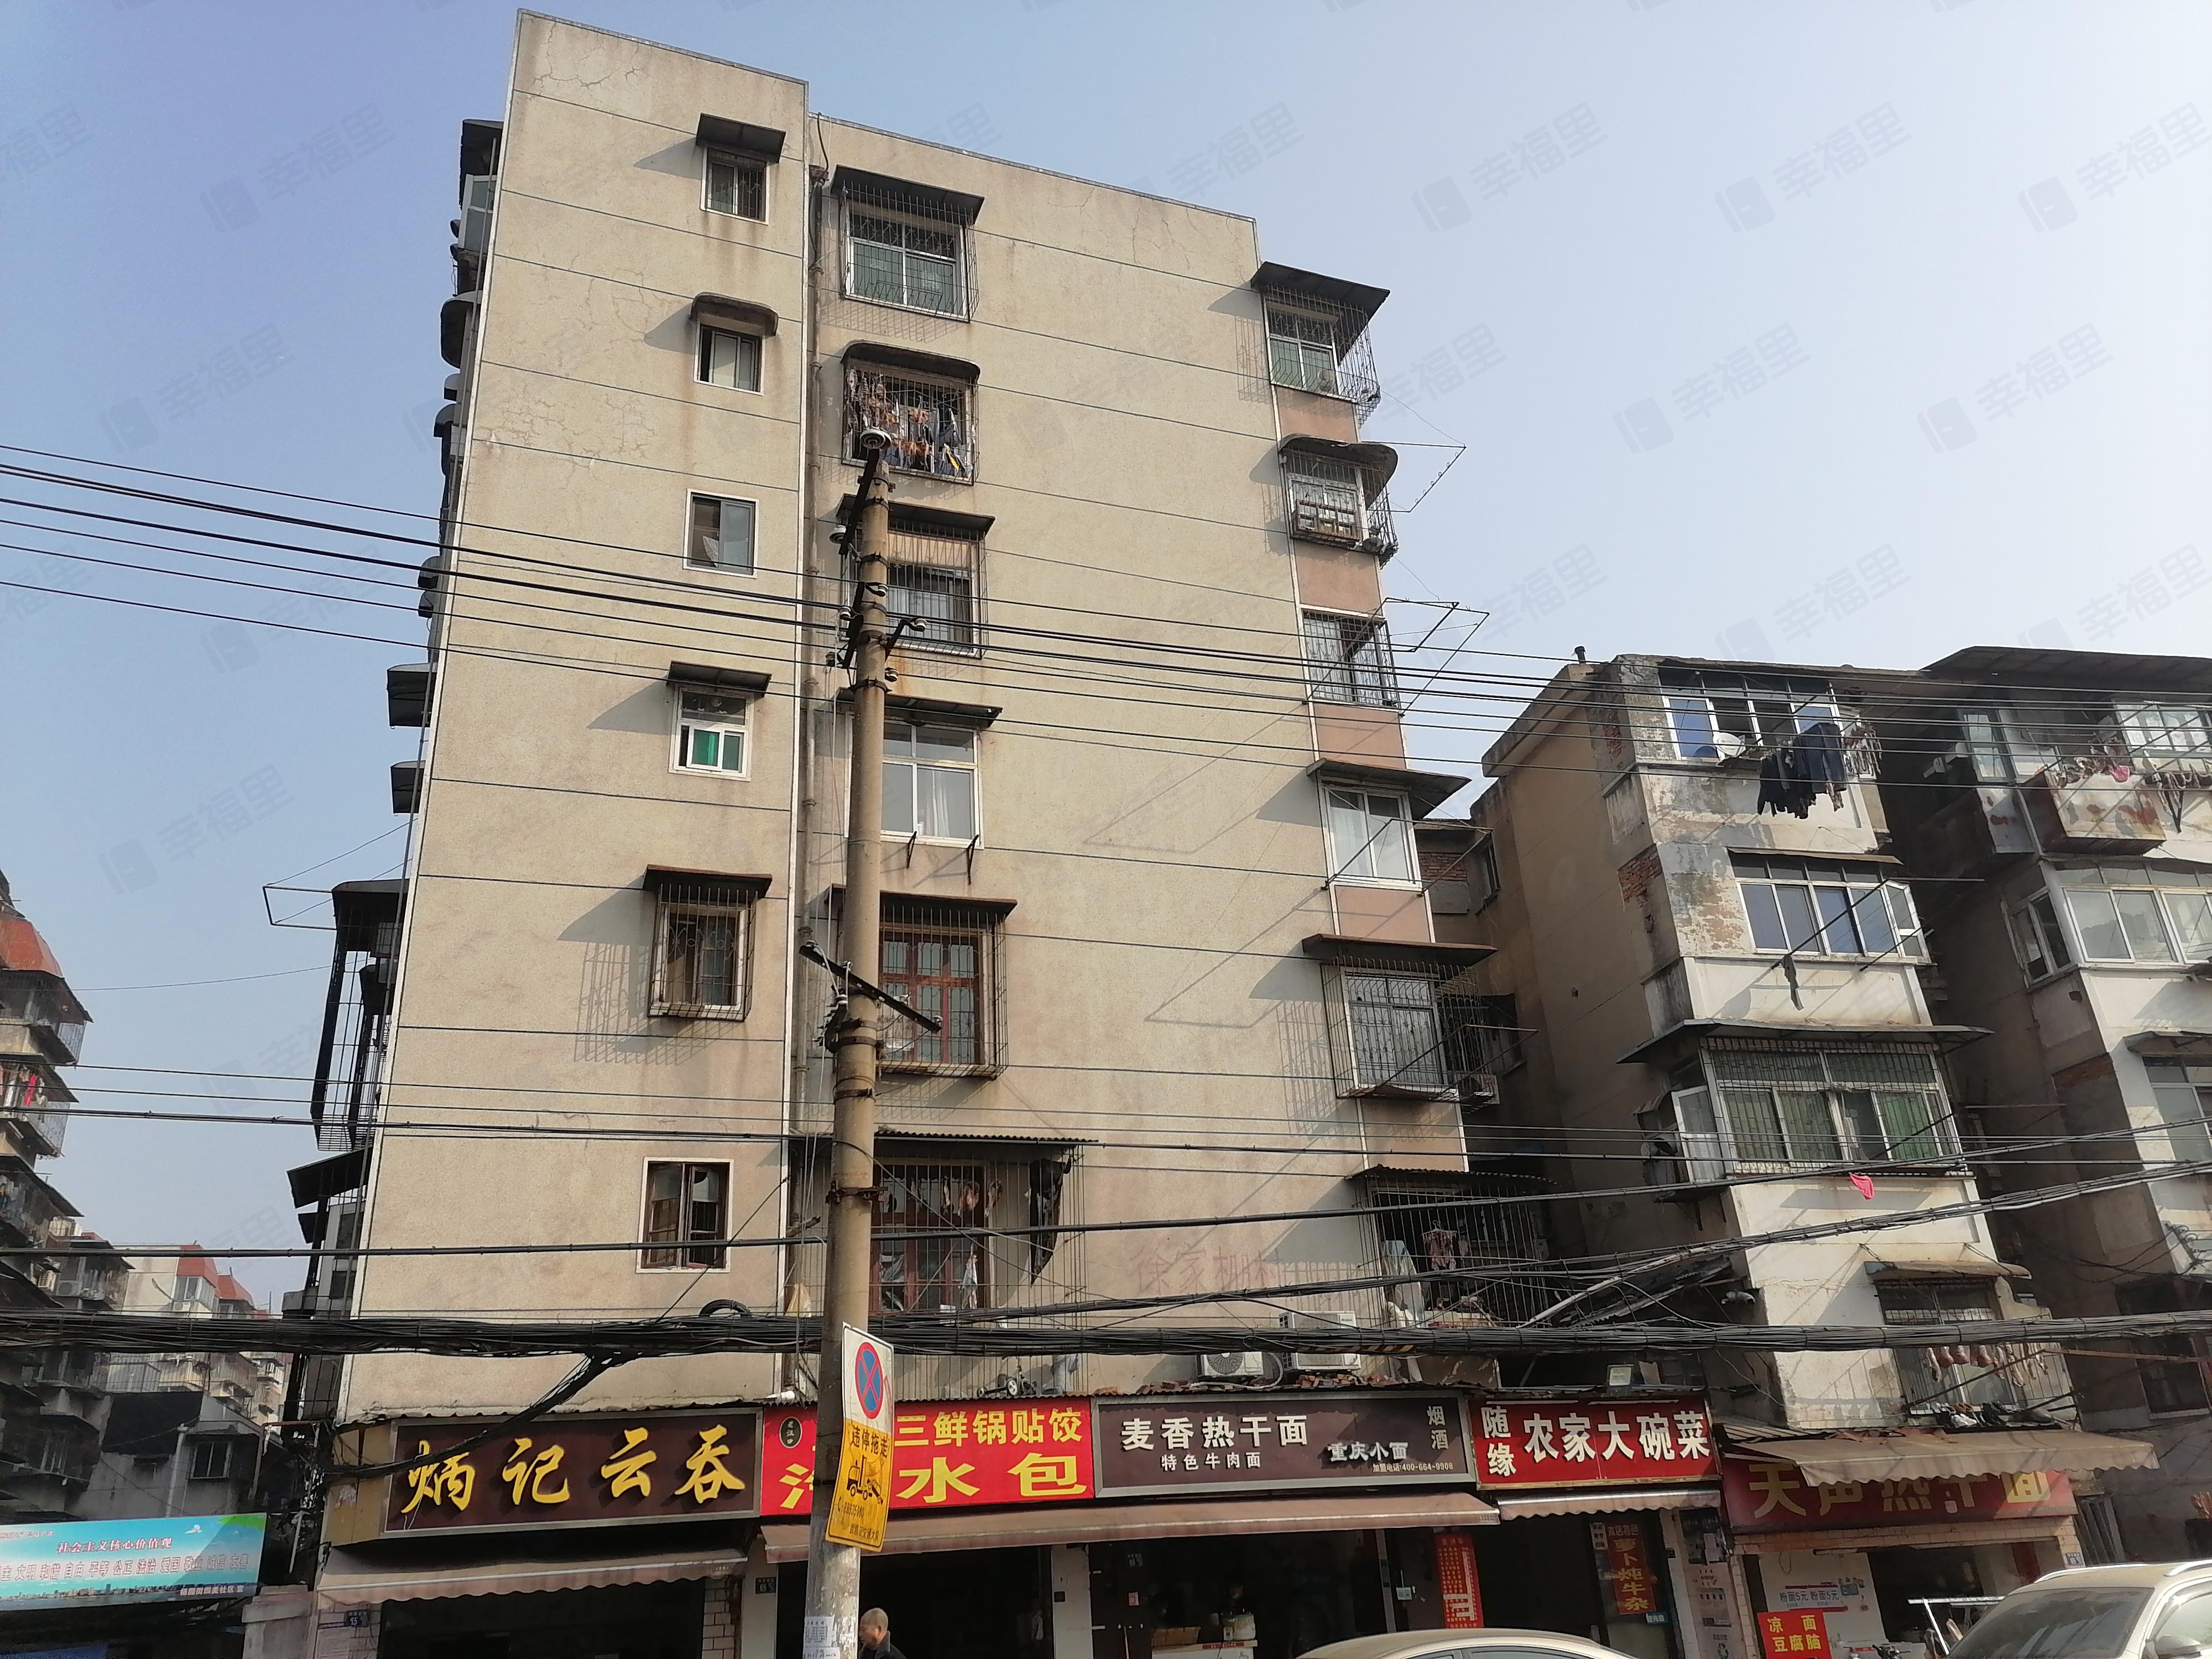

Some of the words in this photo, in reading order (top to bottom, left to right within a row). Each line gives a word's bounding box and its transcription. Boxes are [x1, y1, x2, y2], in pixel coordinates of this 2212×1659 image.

[850, 1425, 888, 1459] 违停拖走
[894, 1407, 1082, 1448] 三鲜锅贴饺
[1121, 1415, 1308, 1451] 麦香热干面
[1426, 1405, 1449, 1451] 烟酒
[1480, 1405, 1517, 1477] 随缘
[1524, 1411, 1710, 1463] 农家大碗菜
[1161, 1452, 1261, 1472] 特色牛肉面
[1328, 1441, 1409, 1463] 重庆小面
[57, 1537, 173, 1554] 社会主义核心价值观
[15, 1564, 36, 1580] 文明
[40, 1563, 61, 1580] 和谐
[64, 1562, 84, 1578] 自由
[89, 1561, 110, 1577] 平等
[113, 1559, 133, 1575] 公正
[136, 1557, 156, 1574] 法治
[160, 1557, 181, 1573] 爱国
[184, 1555, 203, 1572] 敬业
[207, 1554, 227, 1571] 诚信
[229, 1553, 248, 1569] 友善
[1613, 1538, 1649, 1611] 萝卜炖牛杂
[1767, 1614, 1817, 1634] 凉面
[1772, 1634, 1822, 1653] 豆腐脑
